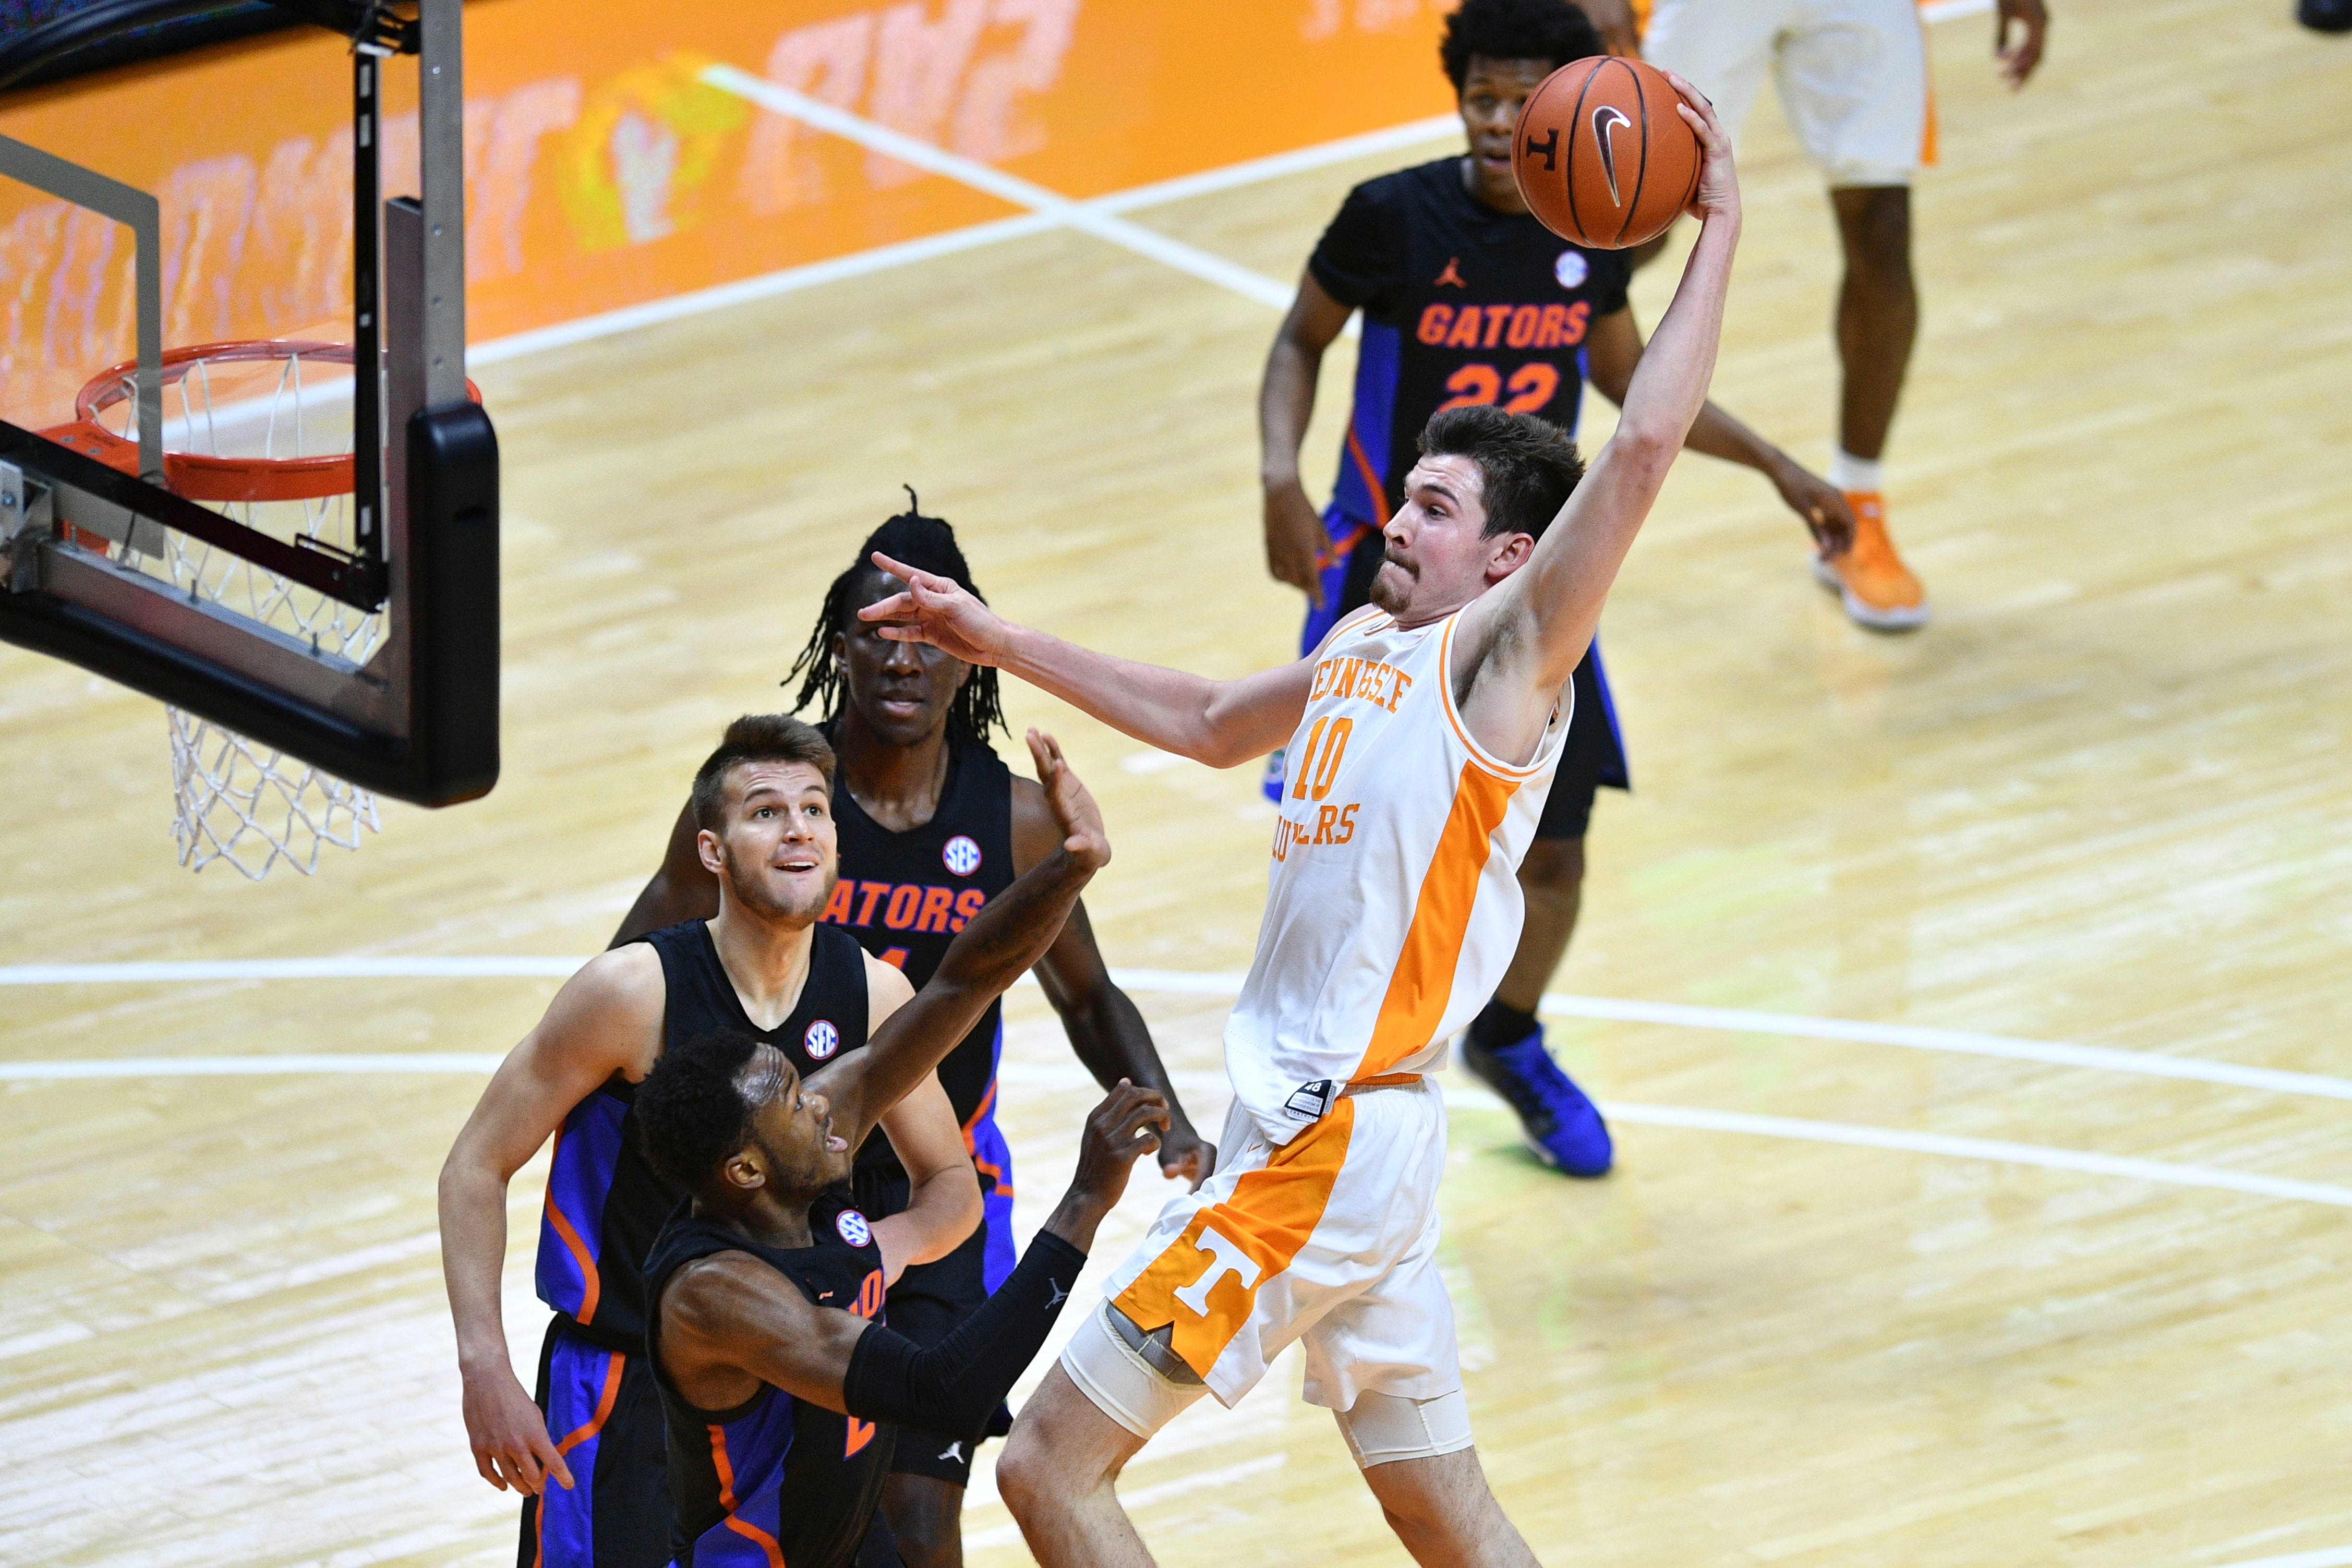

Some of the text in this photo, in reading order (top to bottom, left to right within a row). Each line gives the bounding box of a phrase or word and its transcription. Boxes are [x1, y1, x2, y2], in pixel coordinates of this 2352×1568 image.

[1527, 128, 1559, 171] T
[1416, 301, 1591, 350] GATORS
[1436, 362, 1560, 416] 22
[1292, 716, 1353, 801] 10
[945, 838, 980, 873] SEC
[815, 878, 985, 933] ATORS
[806, 1022, 836, 1058] SEC
[1304, 1082, 1322, 1092] 48
[838, 1212, 870, 1245] SEC
[1173, 1225, 1262, 1318] T
